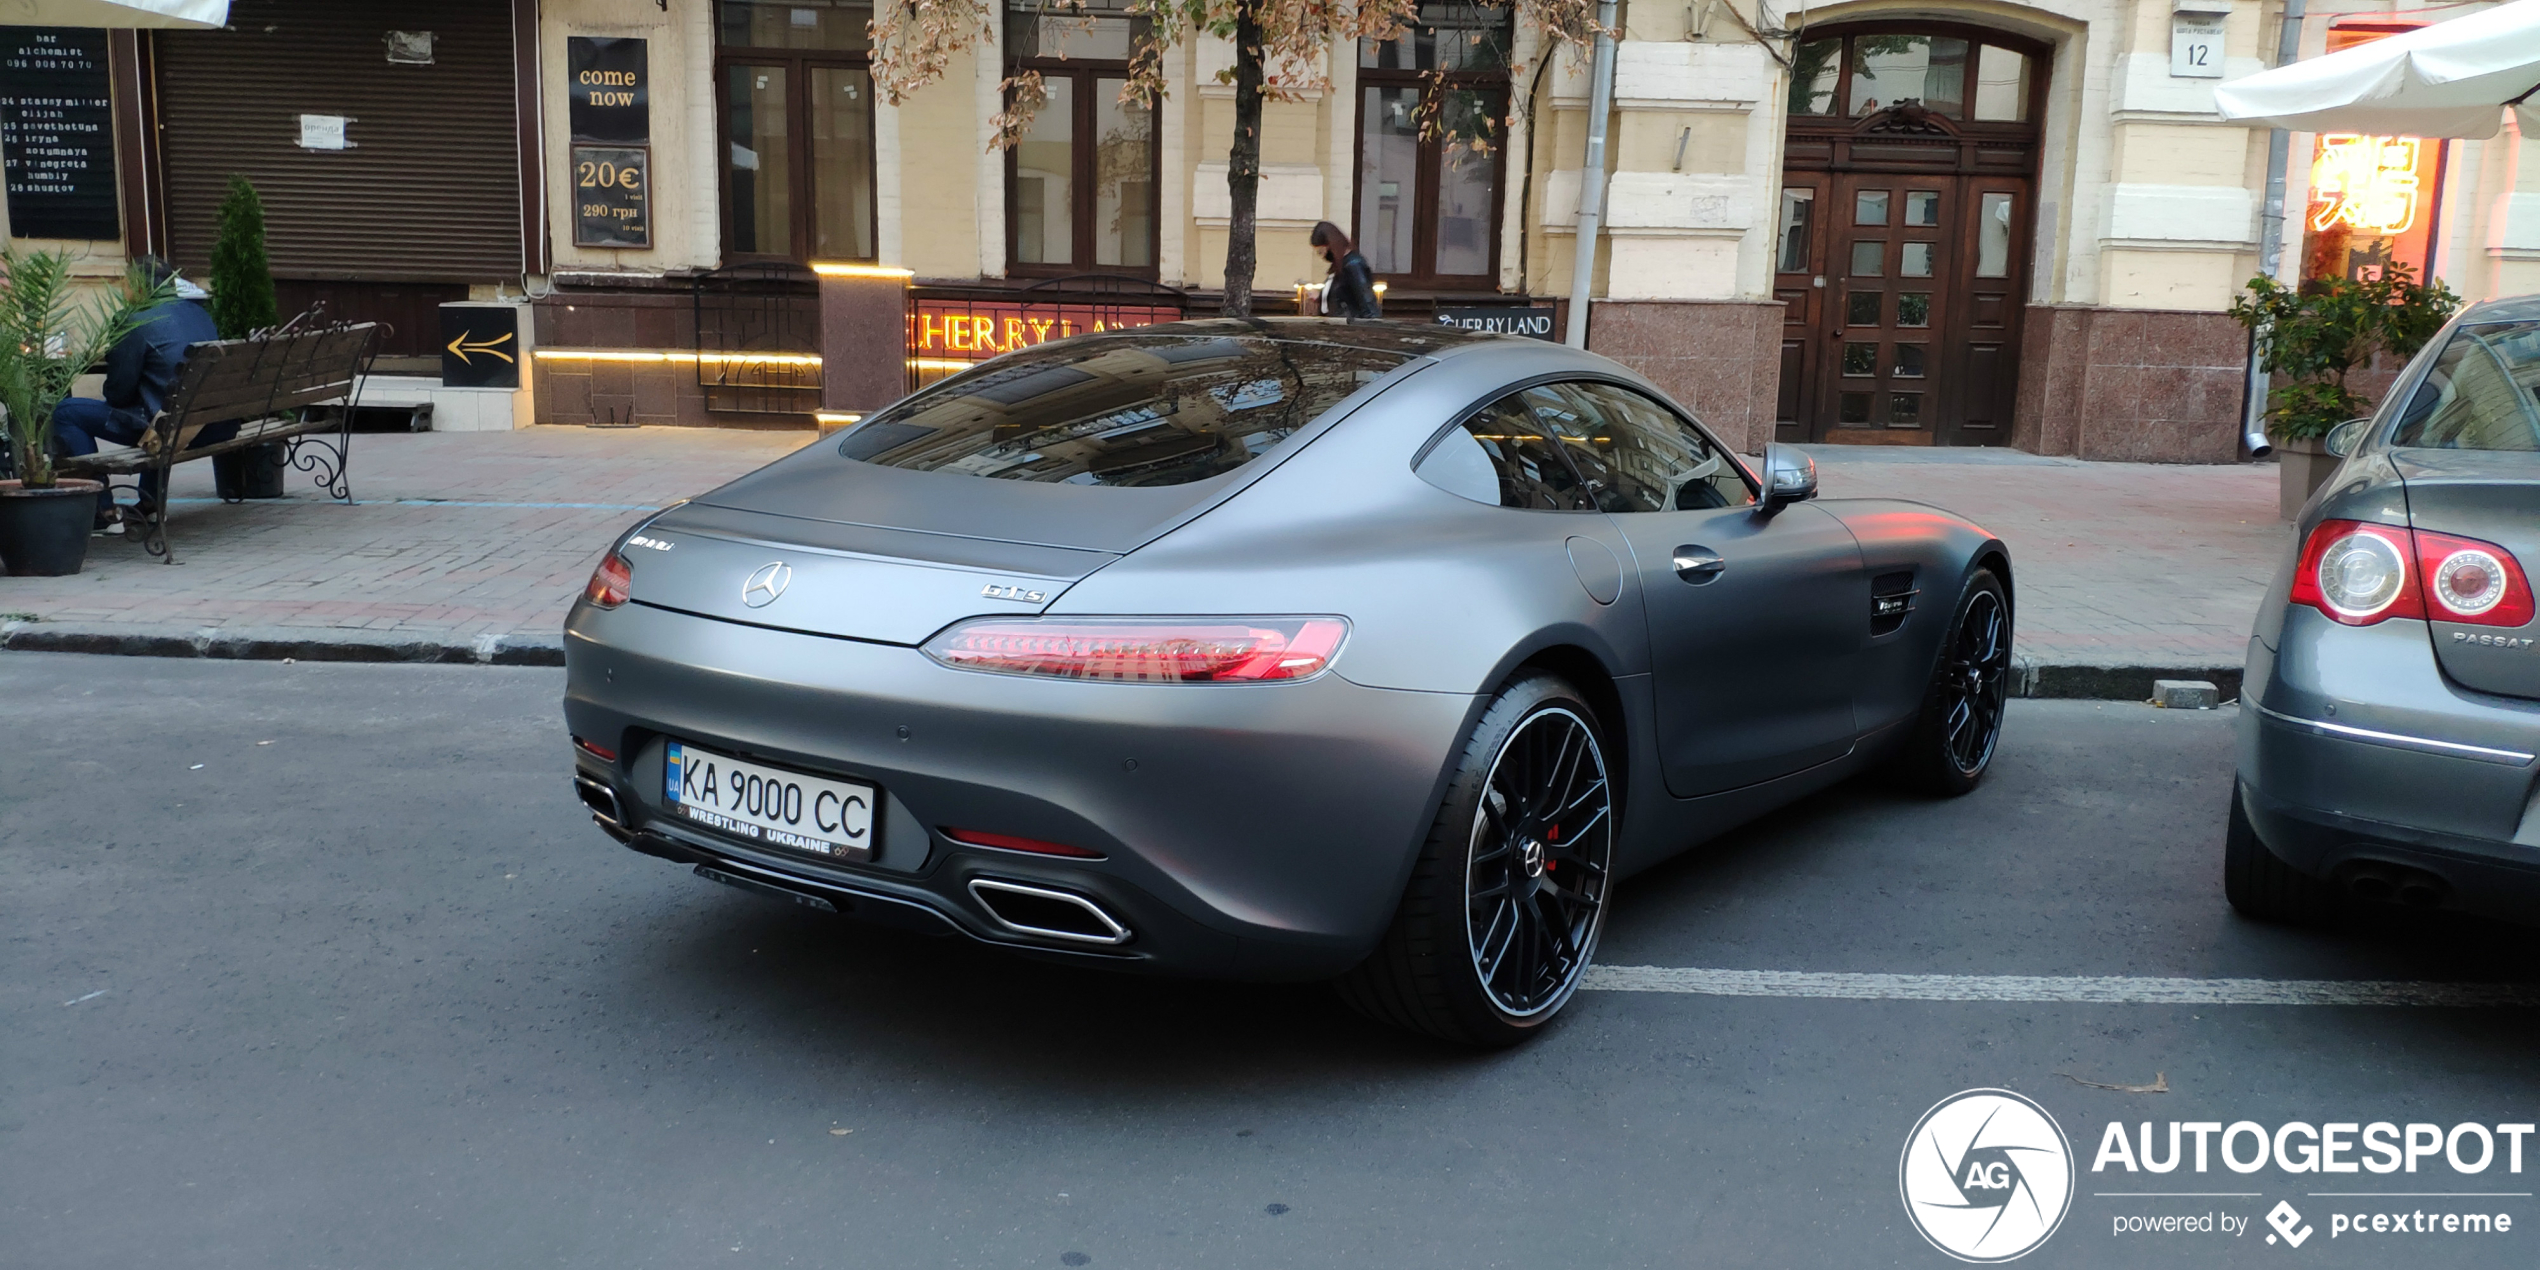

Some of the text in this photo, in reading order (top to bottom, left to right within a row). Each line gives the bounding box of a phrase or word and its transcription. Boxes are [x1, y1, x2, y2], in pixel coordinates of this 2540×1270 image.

[36, 35, 57, 43] bar
[18, 47, 83, 56] alchemist
[2188, 44, 2208, 66] 12
[579, 70, 636, 87] come
[589, 91, 635, 107] now
[579, 161, 640, 189] 20€
[583, 204, 638, 220] 290 грн
[2453, 632, 2535, 651] PASSAT
[668, 778, 680, 794] UA
[683, 755, 867, 839] KA 9000 CC
[688, 806, 831, 854] WRESTLING UKRAINE
